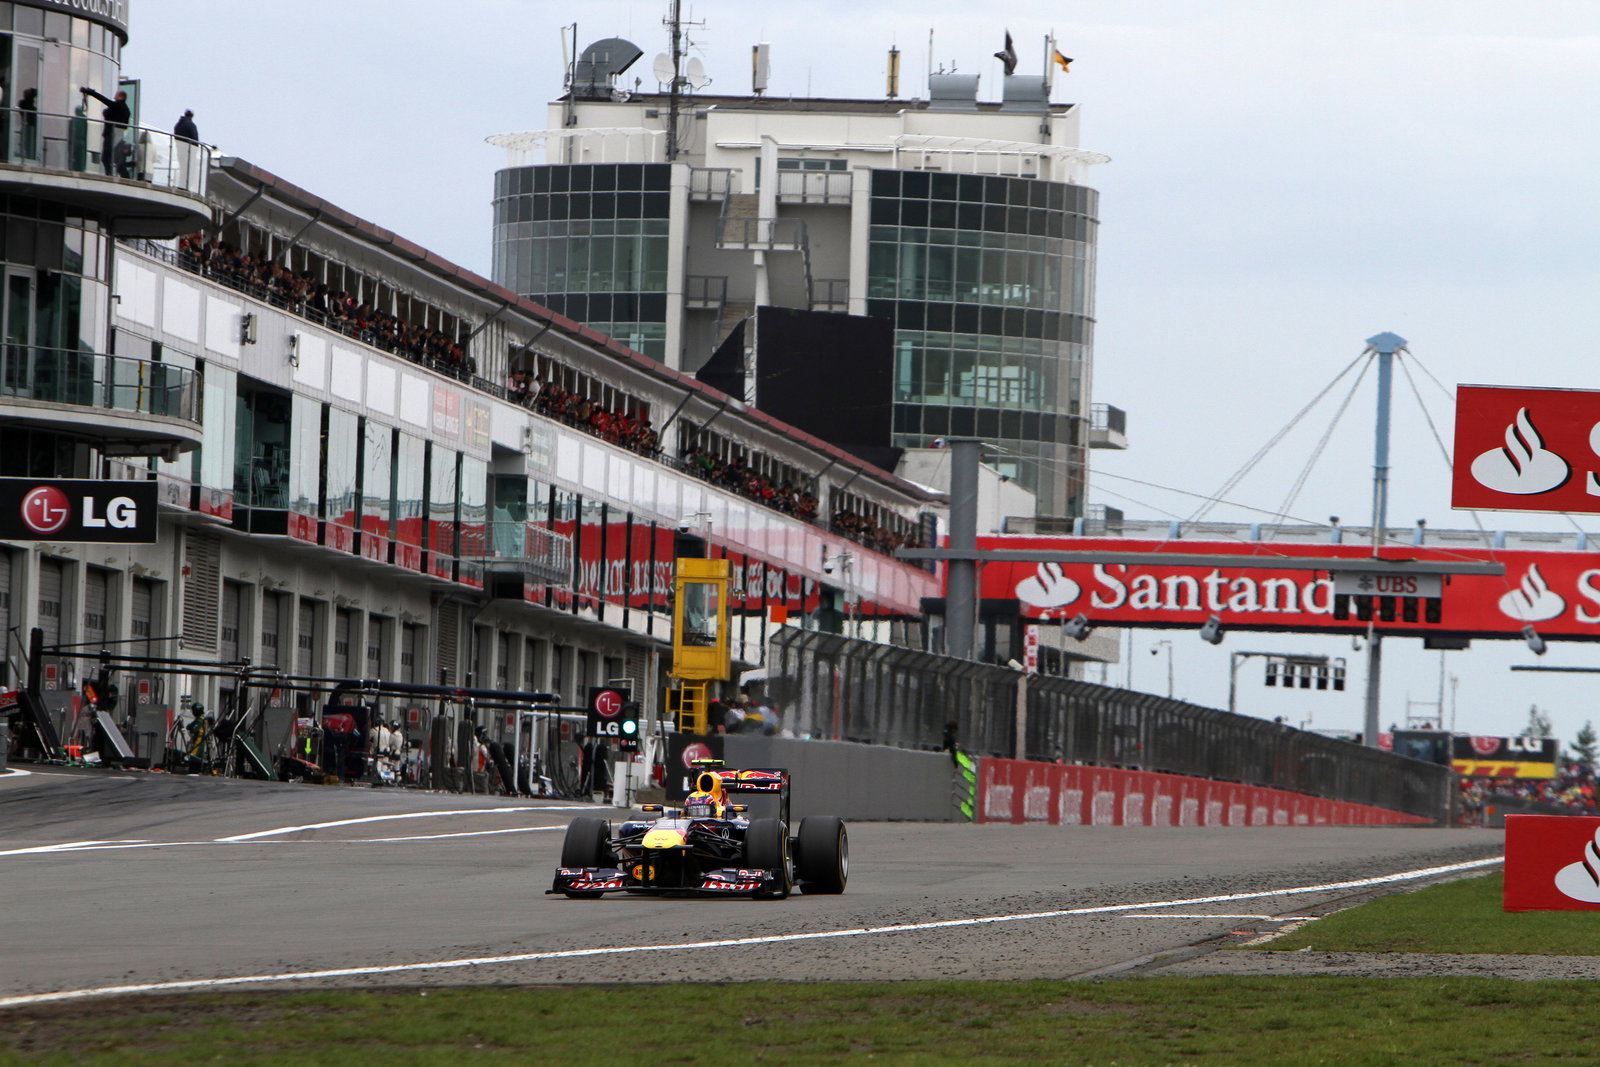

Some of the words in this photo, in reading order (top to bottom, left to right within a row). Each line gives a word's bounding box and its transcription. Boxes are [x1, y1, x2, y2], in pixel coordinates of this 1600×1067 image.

[82, 496, 137, 528] LG
[1091, 563, 1380, 616] Santand
[1376, 575, 1418, 594] UBS
[596, 721, 620, 736] LG
[1507, 736, 1543, 753] LG
